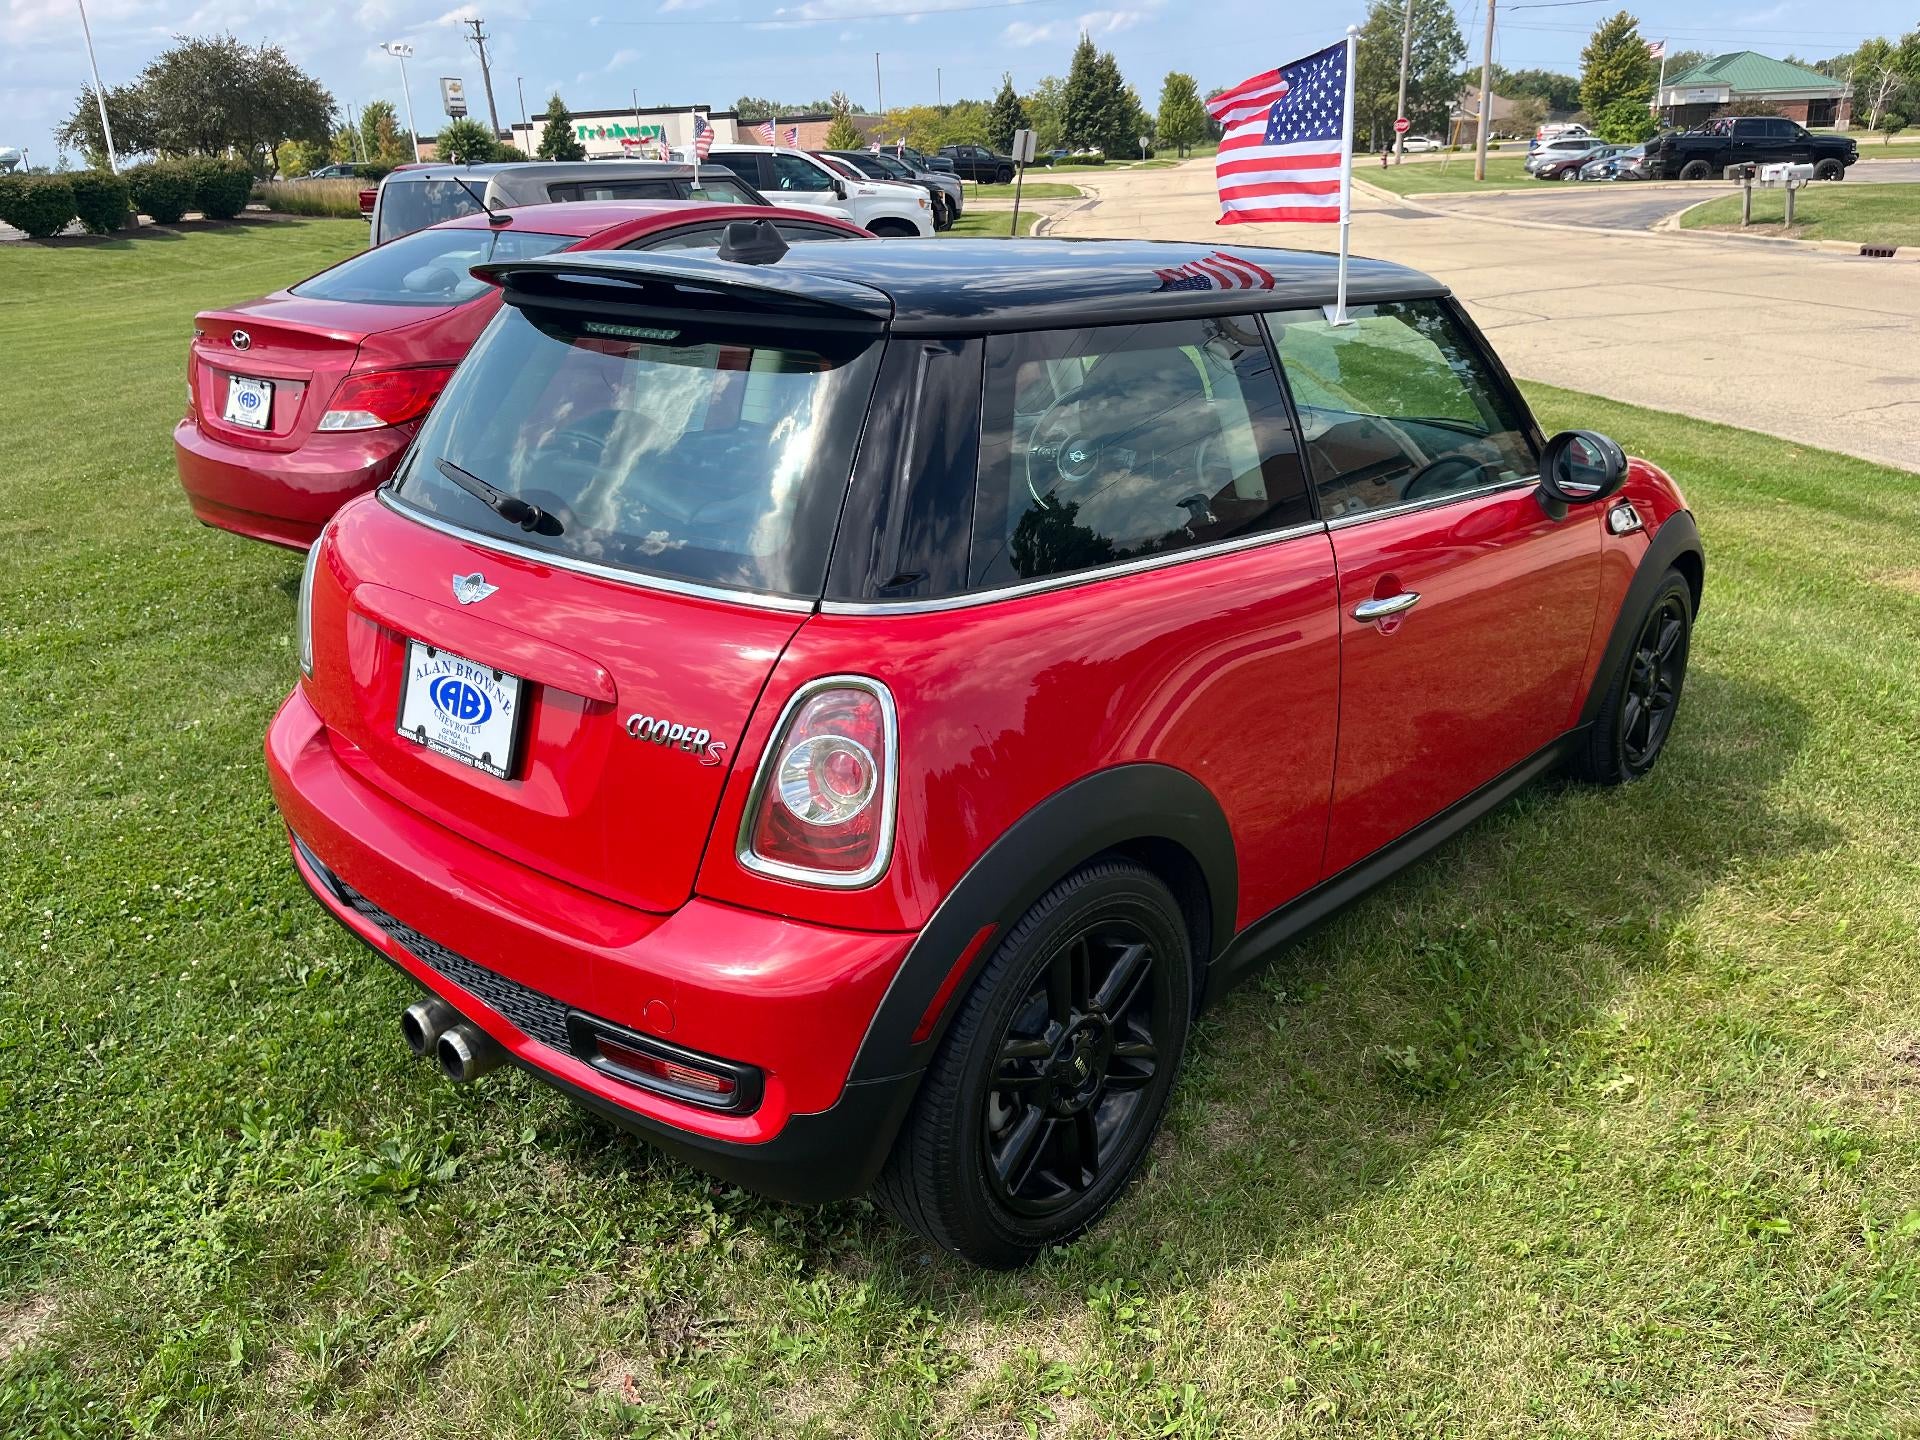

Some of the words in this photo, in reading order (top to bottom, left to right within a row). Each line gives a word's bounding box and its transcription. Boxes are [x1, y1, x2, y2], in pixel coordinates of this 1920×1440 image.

[415, 661, 452, 680] ALAN
[456, 662, 512, 716] BROWNE
[440, 680, 482, 720] AB
[434, 708, 482, 735] CHEVROLET
[626, 713, 711, 756] COOPER
[700, 741, 727, 766] S
